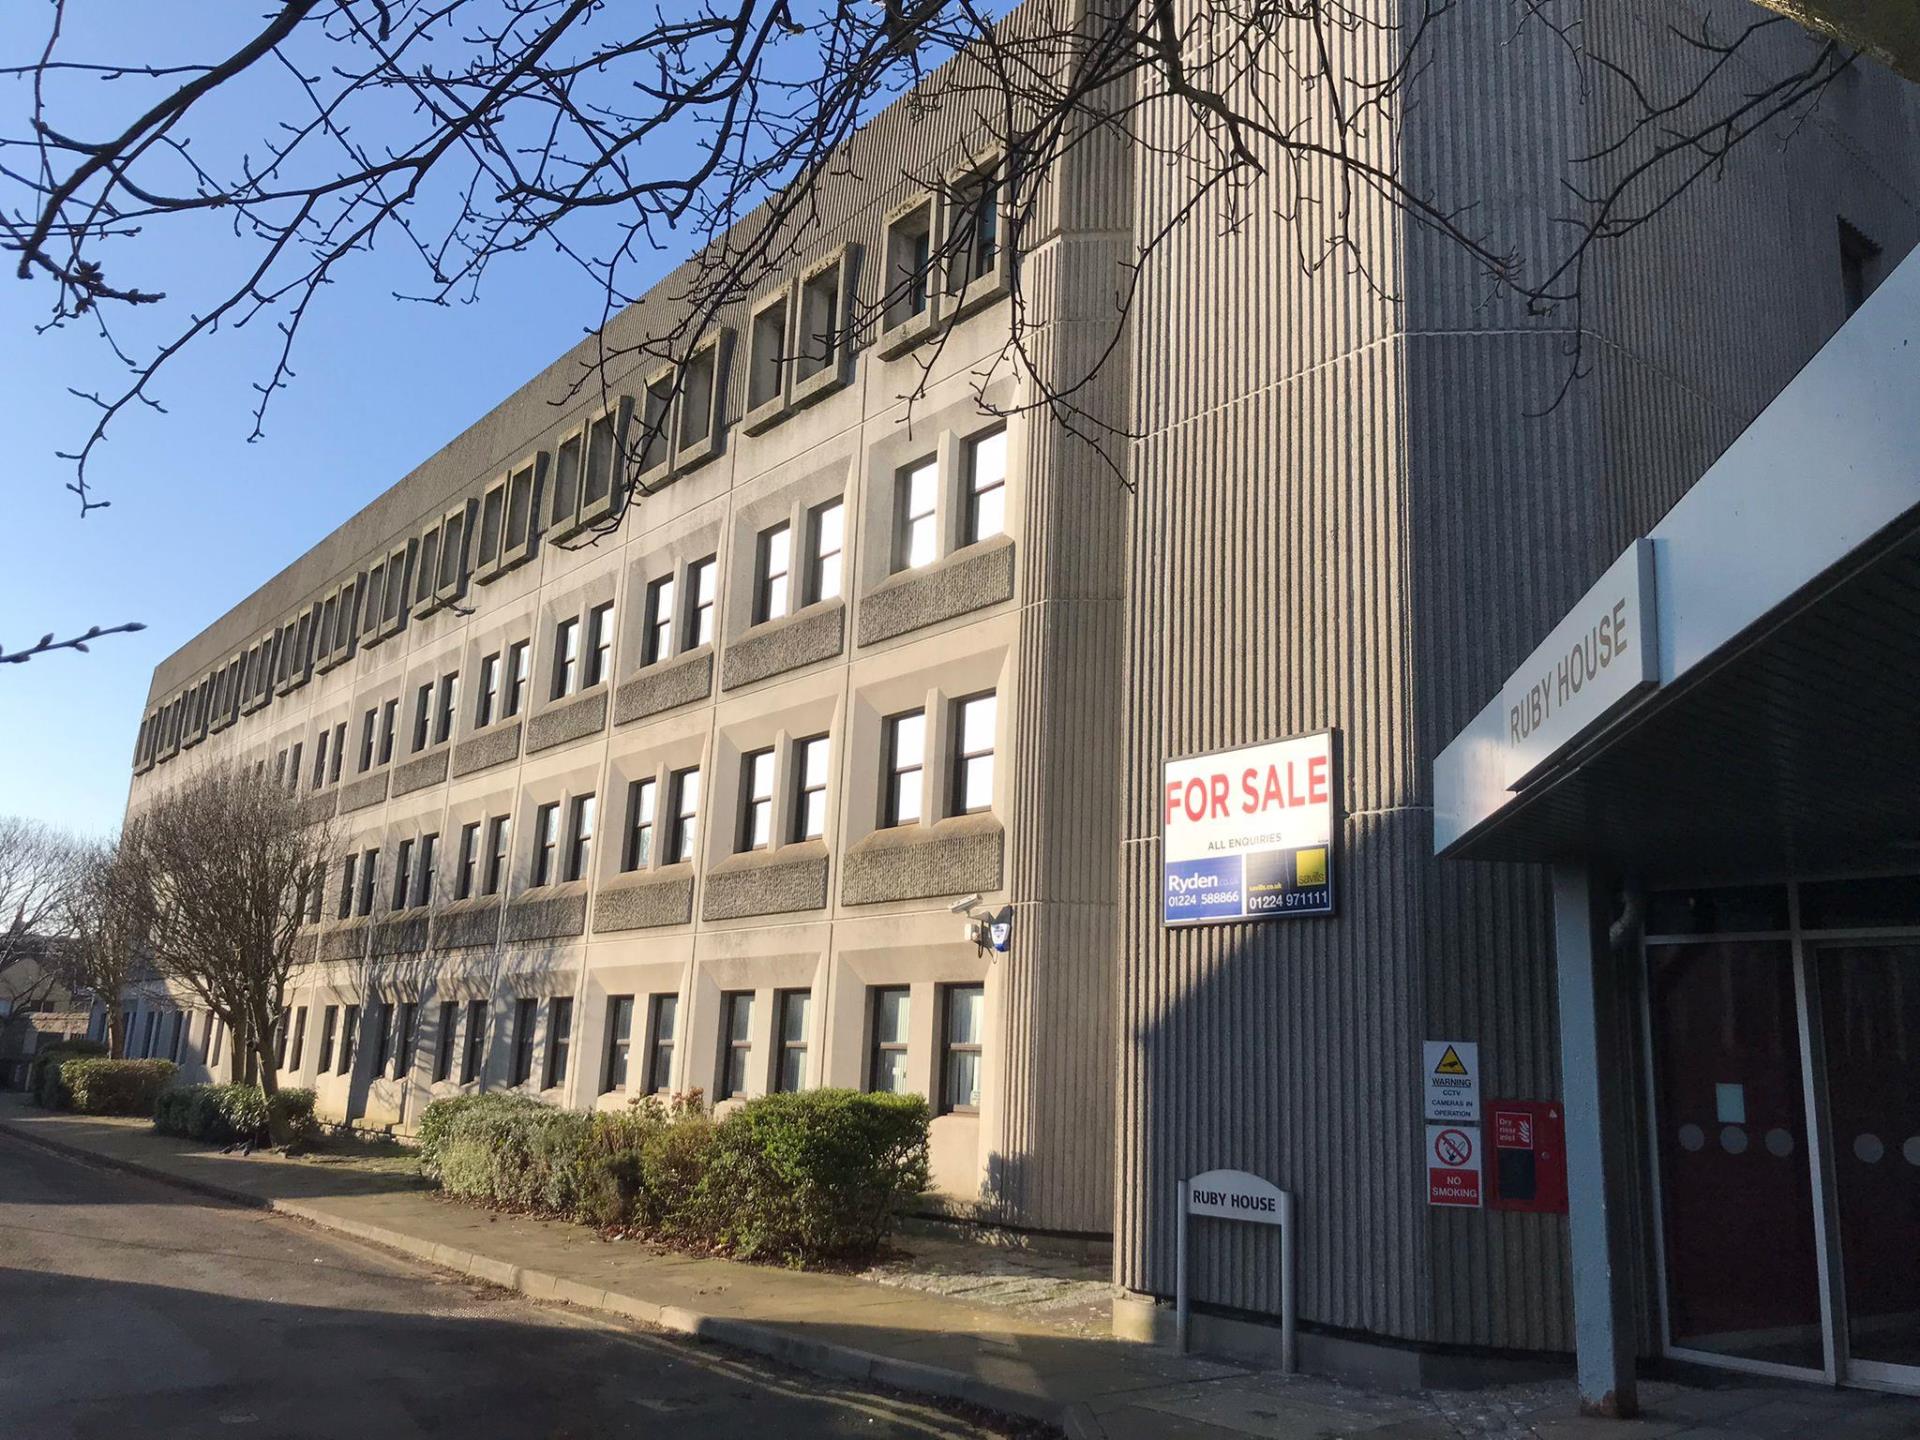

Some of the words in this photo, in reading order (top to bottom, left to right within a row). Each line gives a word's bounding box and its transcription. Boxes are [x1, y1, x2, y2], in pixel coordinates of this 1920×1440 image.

[1510, 671, 1552, 748] RUBY
[1557, 597, 1628, 707] HOUSE
[1166, 773, 1230, 825] FOR
[1241, 755, 1328, 814] SALE
[1208, 839, 1226, 851] ALL
[1229, 832, 1282, 849] ENQUIRIES
[1168, 872, 1218, 894] Ryden
[1168, 894, 1197, 907] 01224
[1201, 891, 1239, 904] 588866
[1249, 895, 1283, 909] 01224
[1286, 890, 1327, 906] 971111
[1432, 1078, 1472, 1087] WARNING
[1432, 1099, 1464, 1107] CAMERAS
[1434, 1110, 1471, 1118] OPERATION
[1447, 1176, 1461, 1185] NO
[1193, 1190, 1226, 1206] RUBY
[1231, 1194, 1276, 1212] HOUSE
[1432, 1188, 1477, 1198] SMOKING
